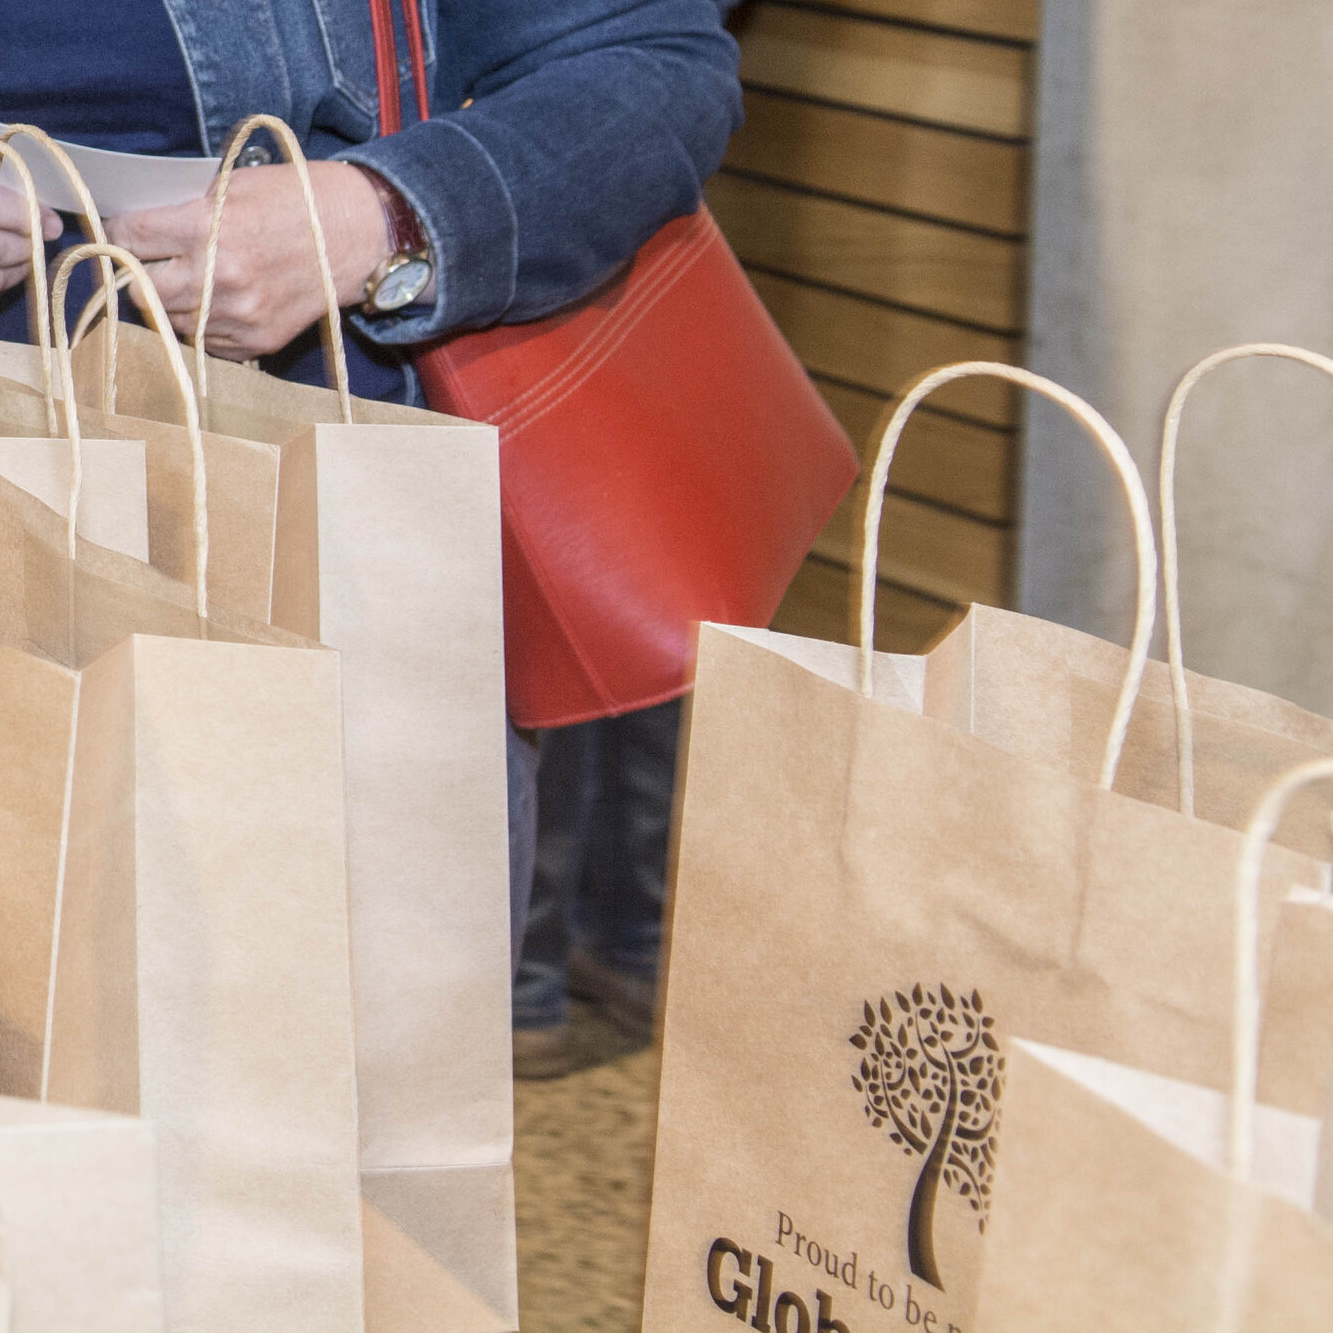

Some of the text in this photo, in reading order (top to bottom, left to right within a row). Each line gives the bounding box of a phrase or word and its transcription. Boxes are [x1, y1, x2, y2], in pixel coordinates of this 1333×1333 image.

[775, 1210, 937, 1333] Proud to be
